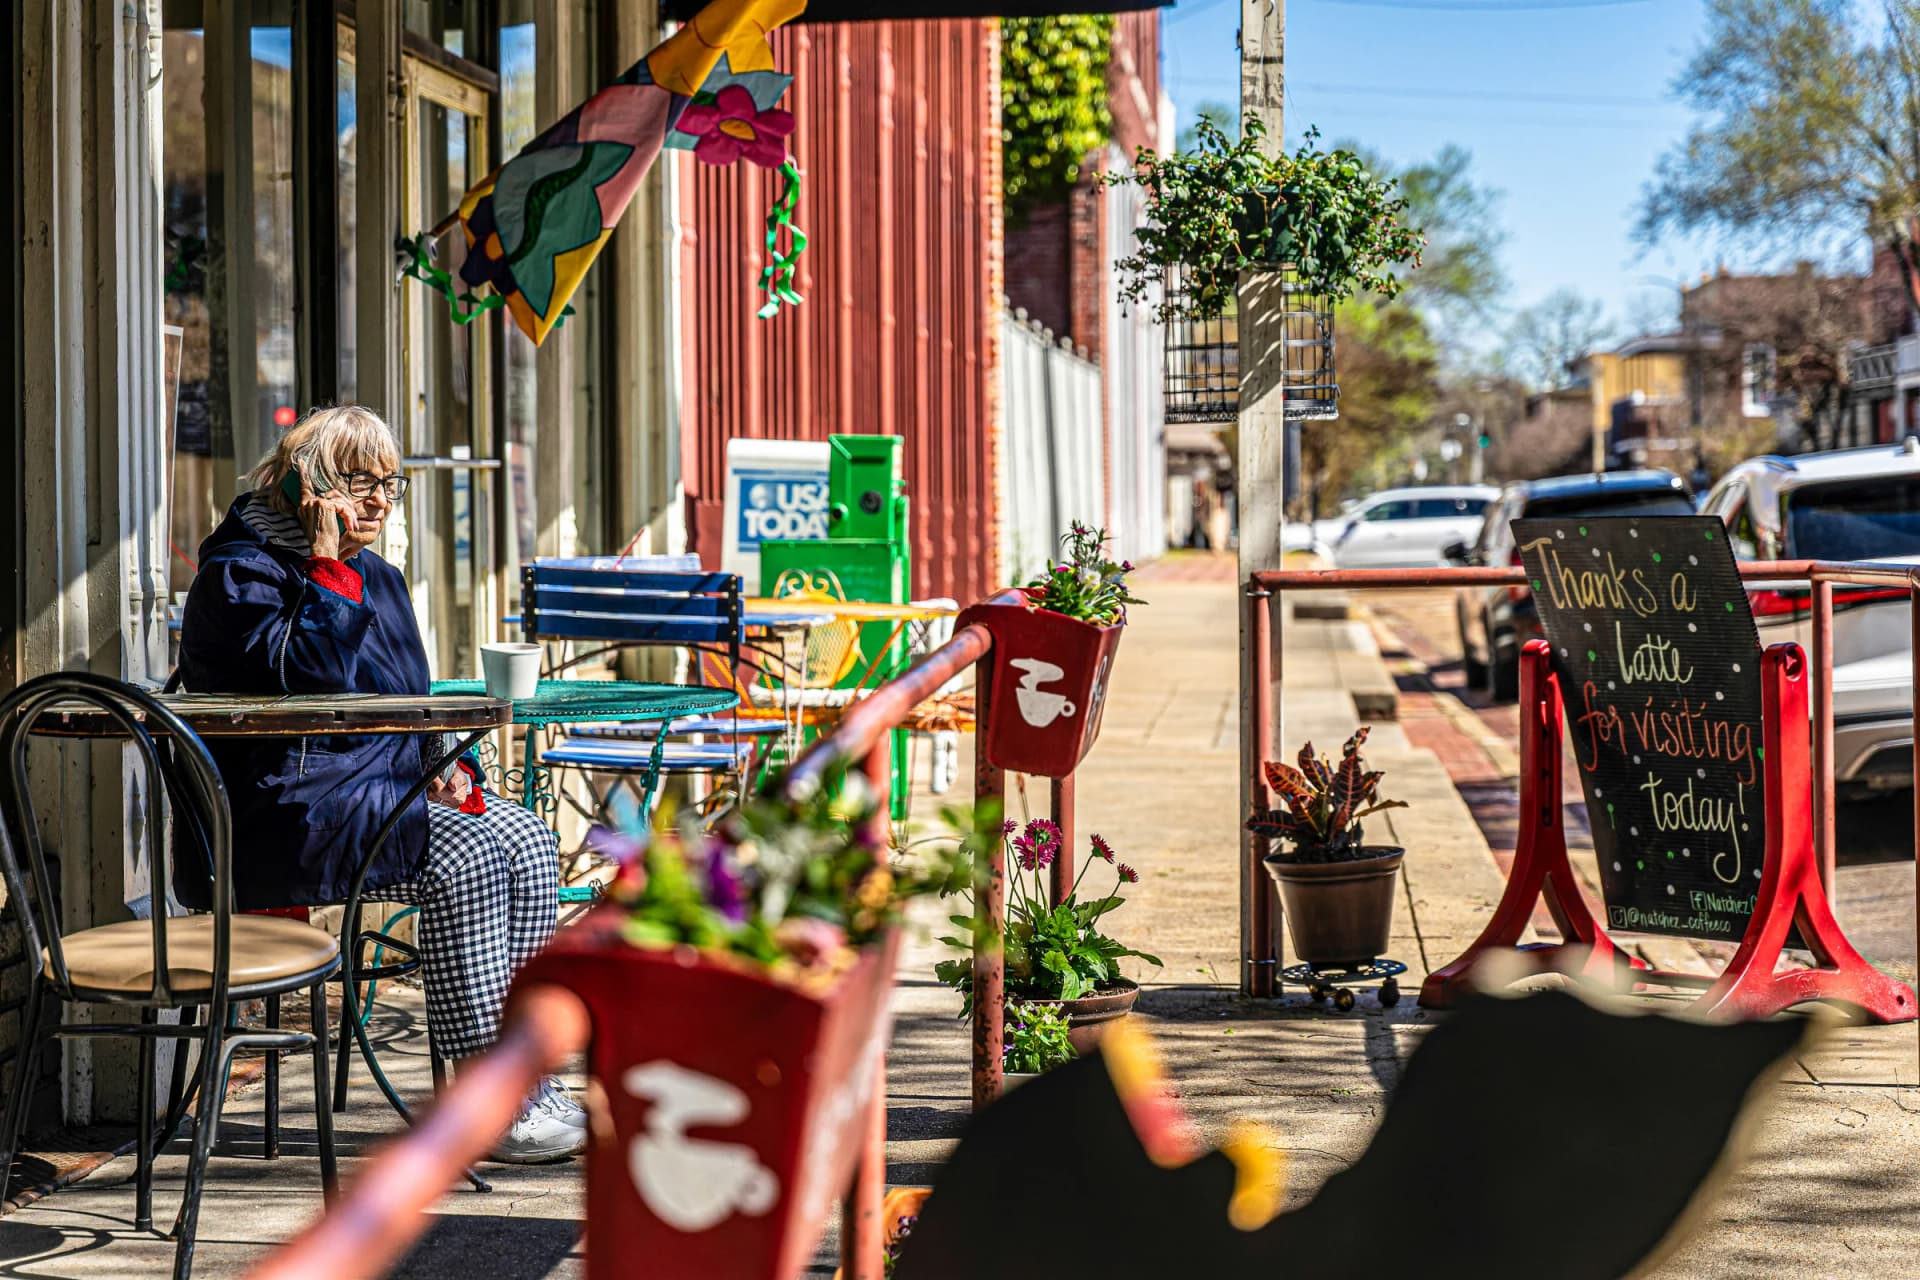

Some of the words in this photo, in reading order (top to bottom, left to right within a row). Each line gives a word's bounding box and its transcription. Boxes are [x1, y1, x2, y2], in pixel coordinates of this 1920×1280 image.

[1521, 537, 1658, 618] Thanks
[1671, 571, 1697, 613] a
[1577, 681, 1628, 773] for
[1631, 696, 1756, 785] visiting
[1640, 771, 1750, 884] today!
